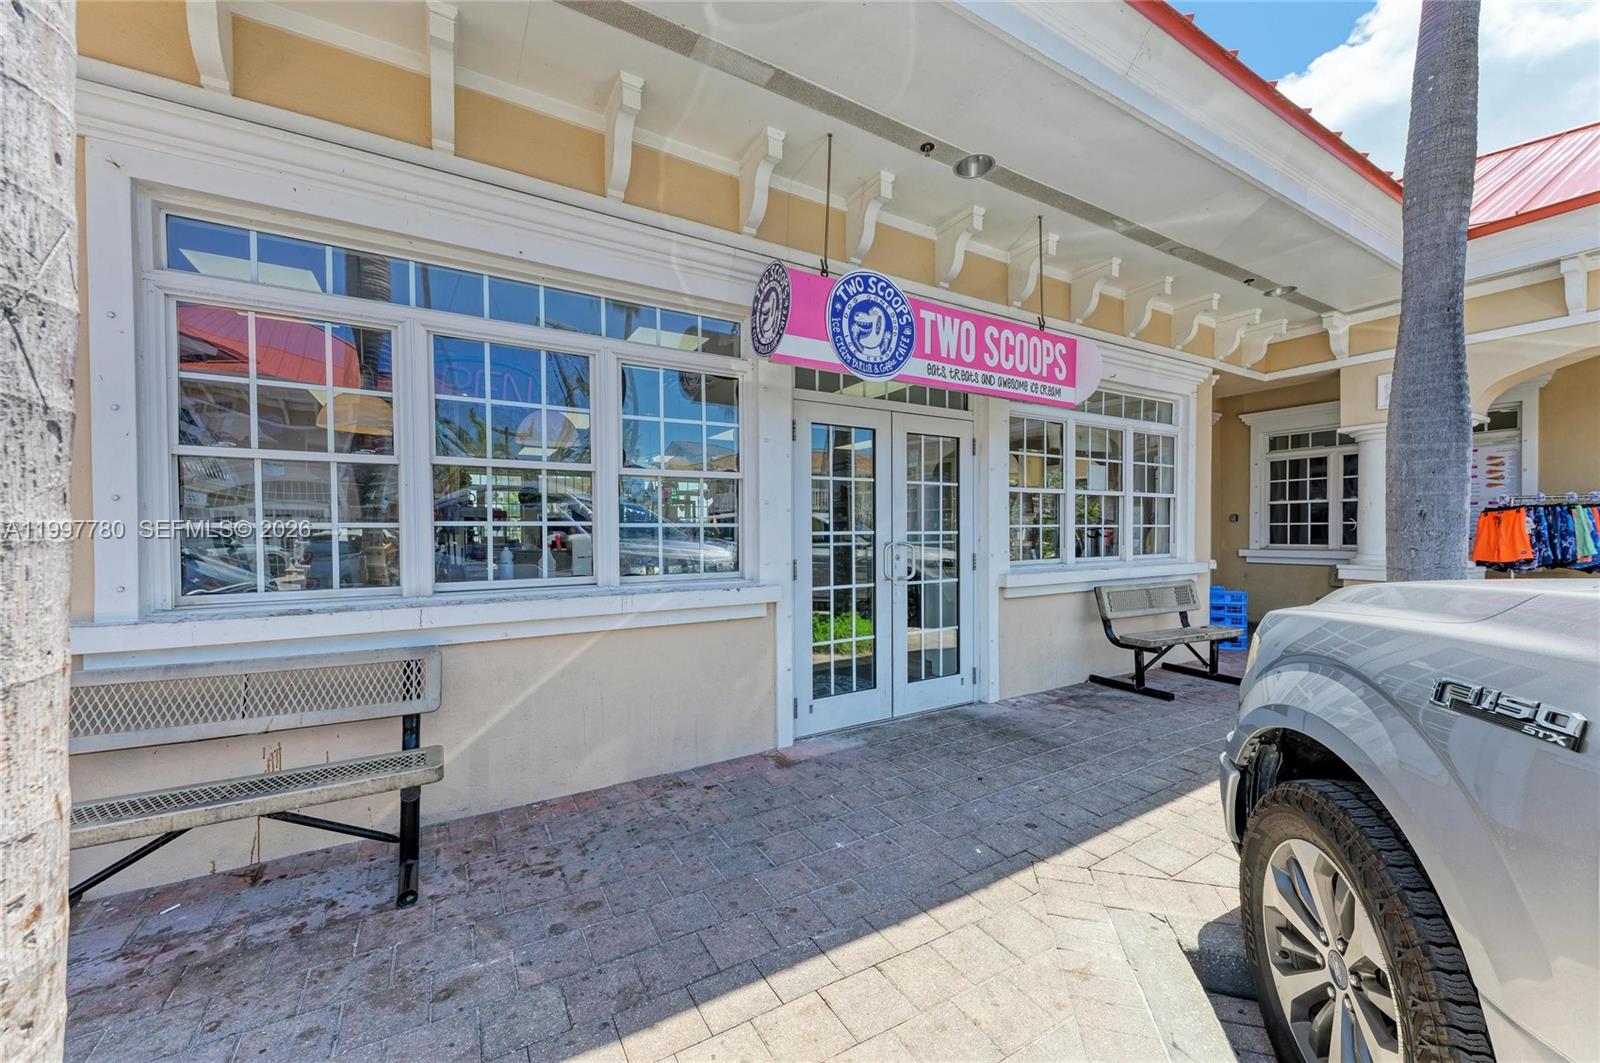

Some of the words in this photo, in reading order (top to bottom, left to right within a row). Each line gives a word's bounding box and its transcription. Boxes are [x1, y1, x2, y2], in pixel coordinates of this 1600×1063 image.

[756, 271, 769, 298] TWO
[770, 264, 790, 298] SCOOPS
[836, 277, 864, 302] TWO
[867, 276, 912, 325] SCOOPS
[832, 317, 841, 332] ice
[895, 335, 910, 360] CAFE
[919, 309, 976, 363] TWO
[983, 325, 1067, 381] SCOOPS
[1521, 723, 1568, 747] STX
